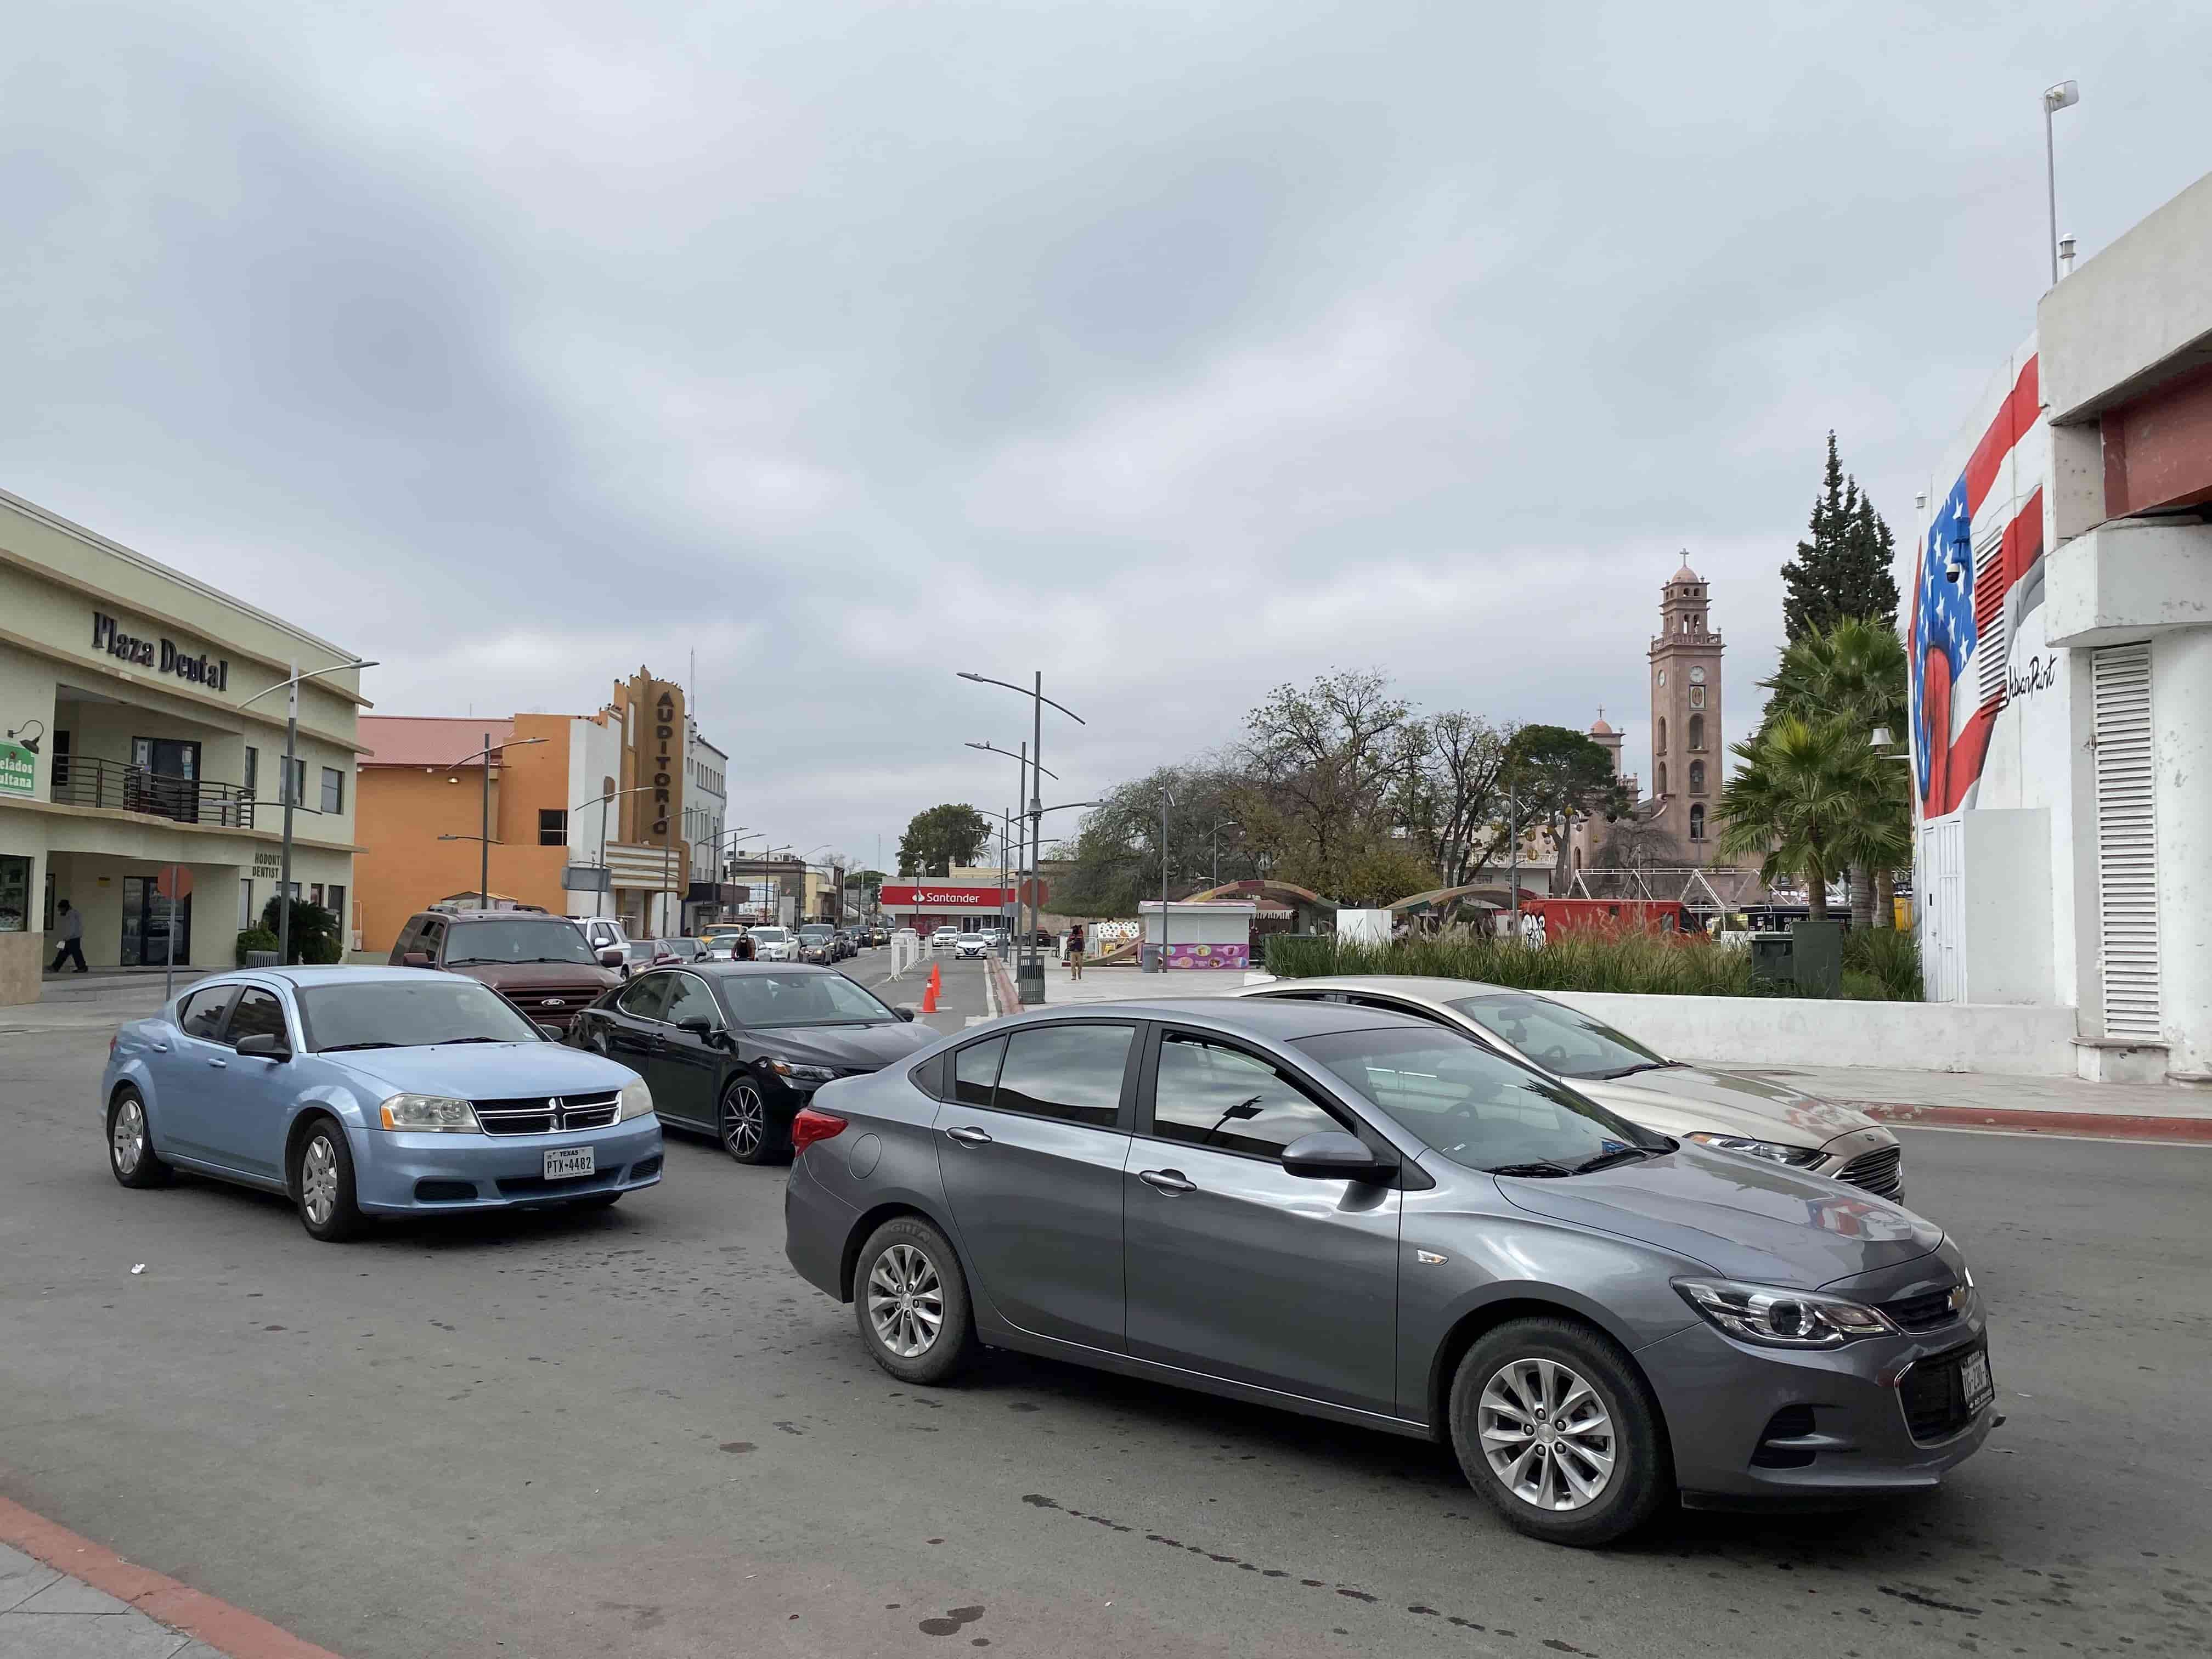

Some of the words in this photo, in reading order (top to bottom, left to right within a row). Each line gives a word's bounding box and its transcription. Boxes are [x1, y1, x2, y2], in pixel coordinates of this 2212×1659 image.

[92, 612, 155, 667] Plaza
[159, 638, 228, 692] Dental
[653, 690, 674, 834] AUDITORIO
[252, 866, 279, 878] DENTIST
[927, 893, 980, 903] Santander
